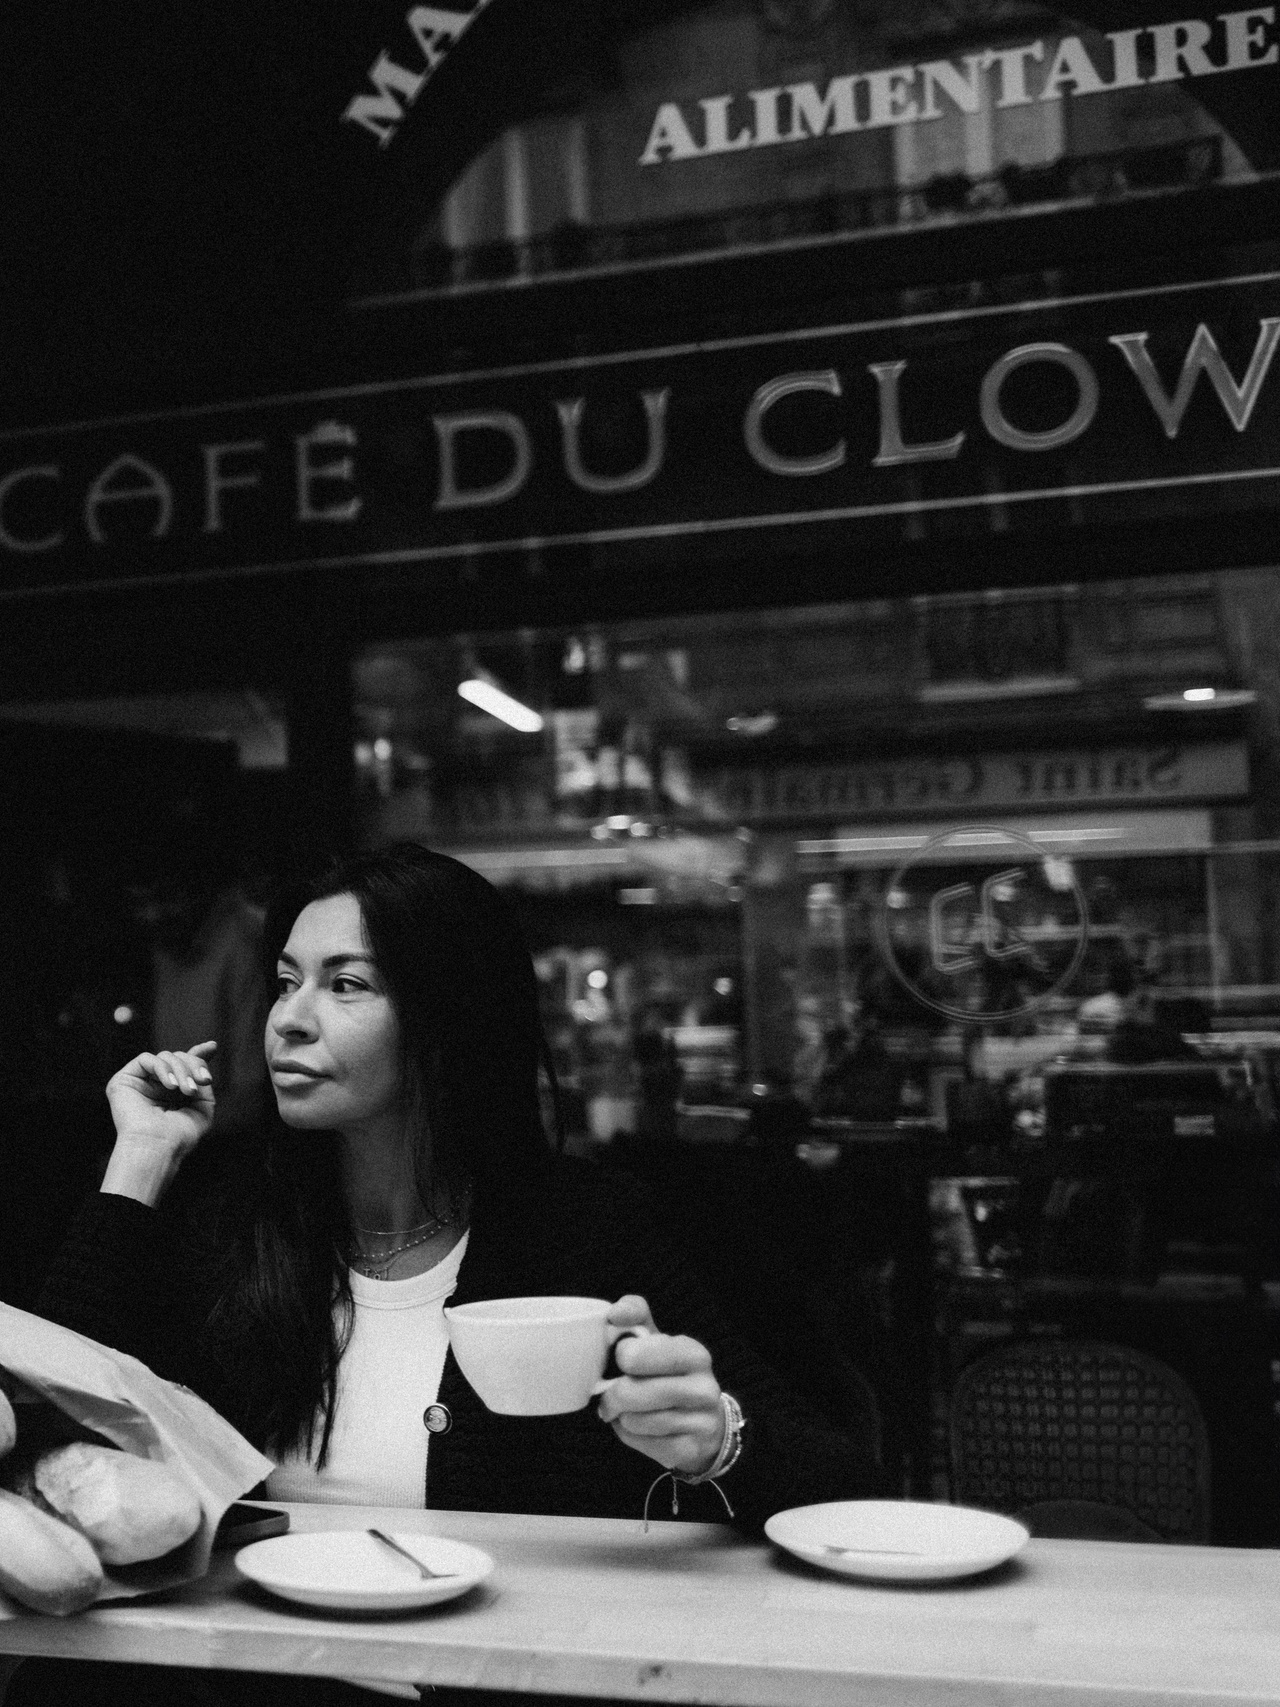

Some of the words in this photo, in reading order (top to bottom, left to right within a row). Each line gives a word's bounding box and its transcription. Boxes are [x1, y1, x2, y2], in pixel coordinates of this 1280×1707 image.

[339, 0, 492, 150] MA
[638, 6, 1280, 166] ALIMENTAIRE
[432, 387, 672, 512] DU
[742, 316, 1280, 478] CLOW
